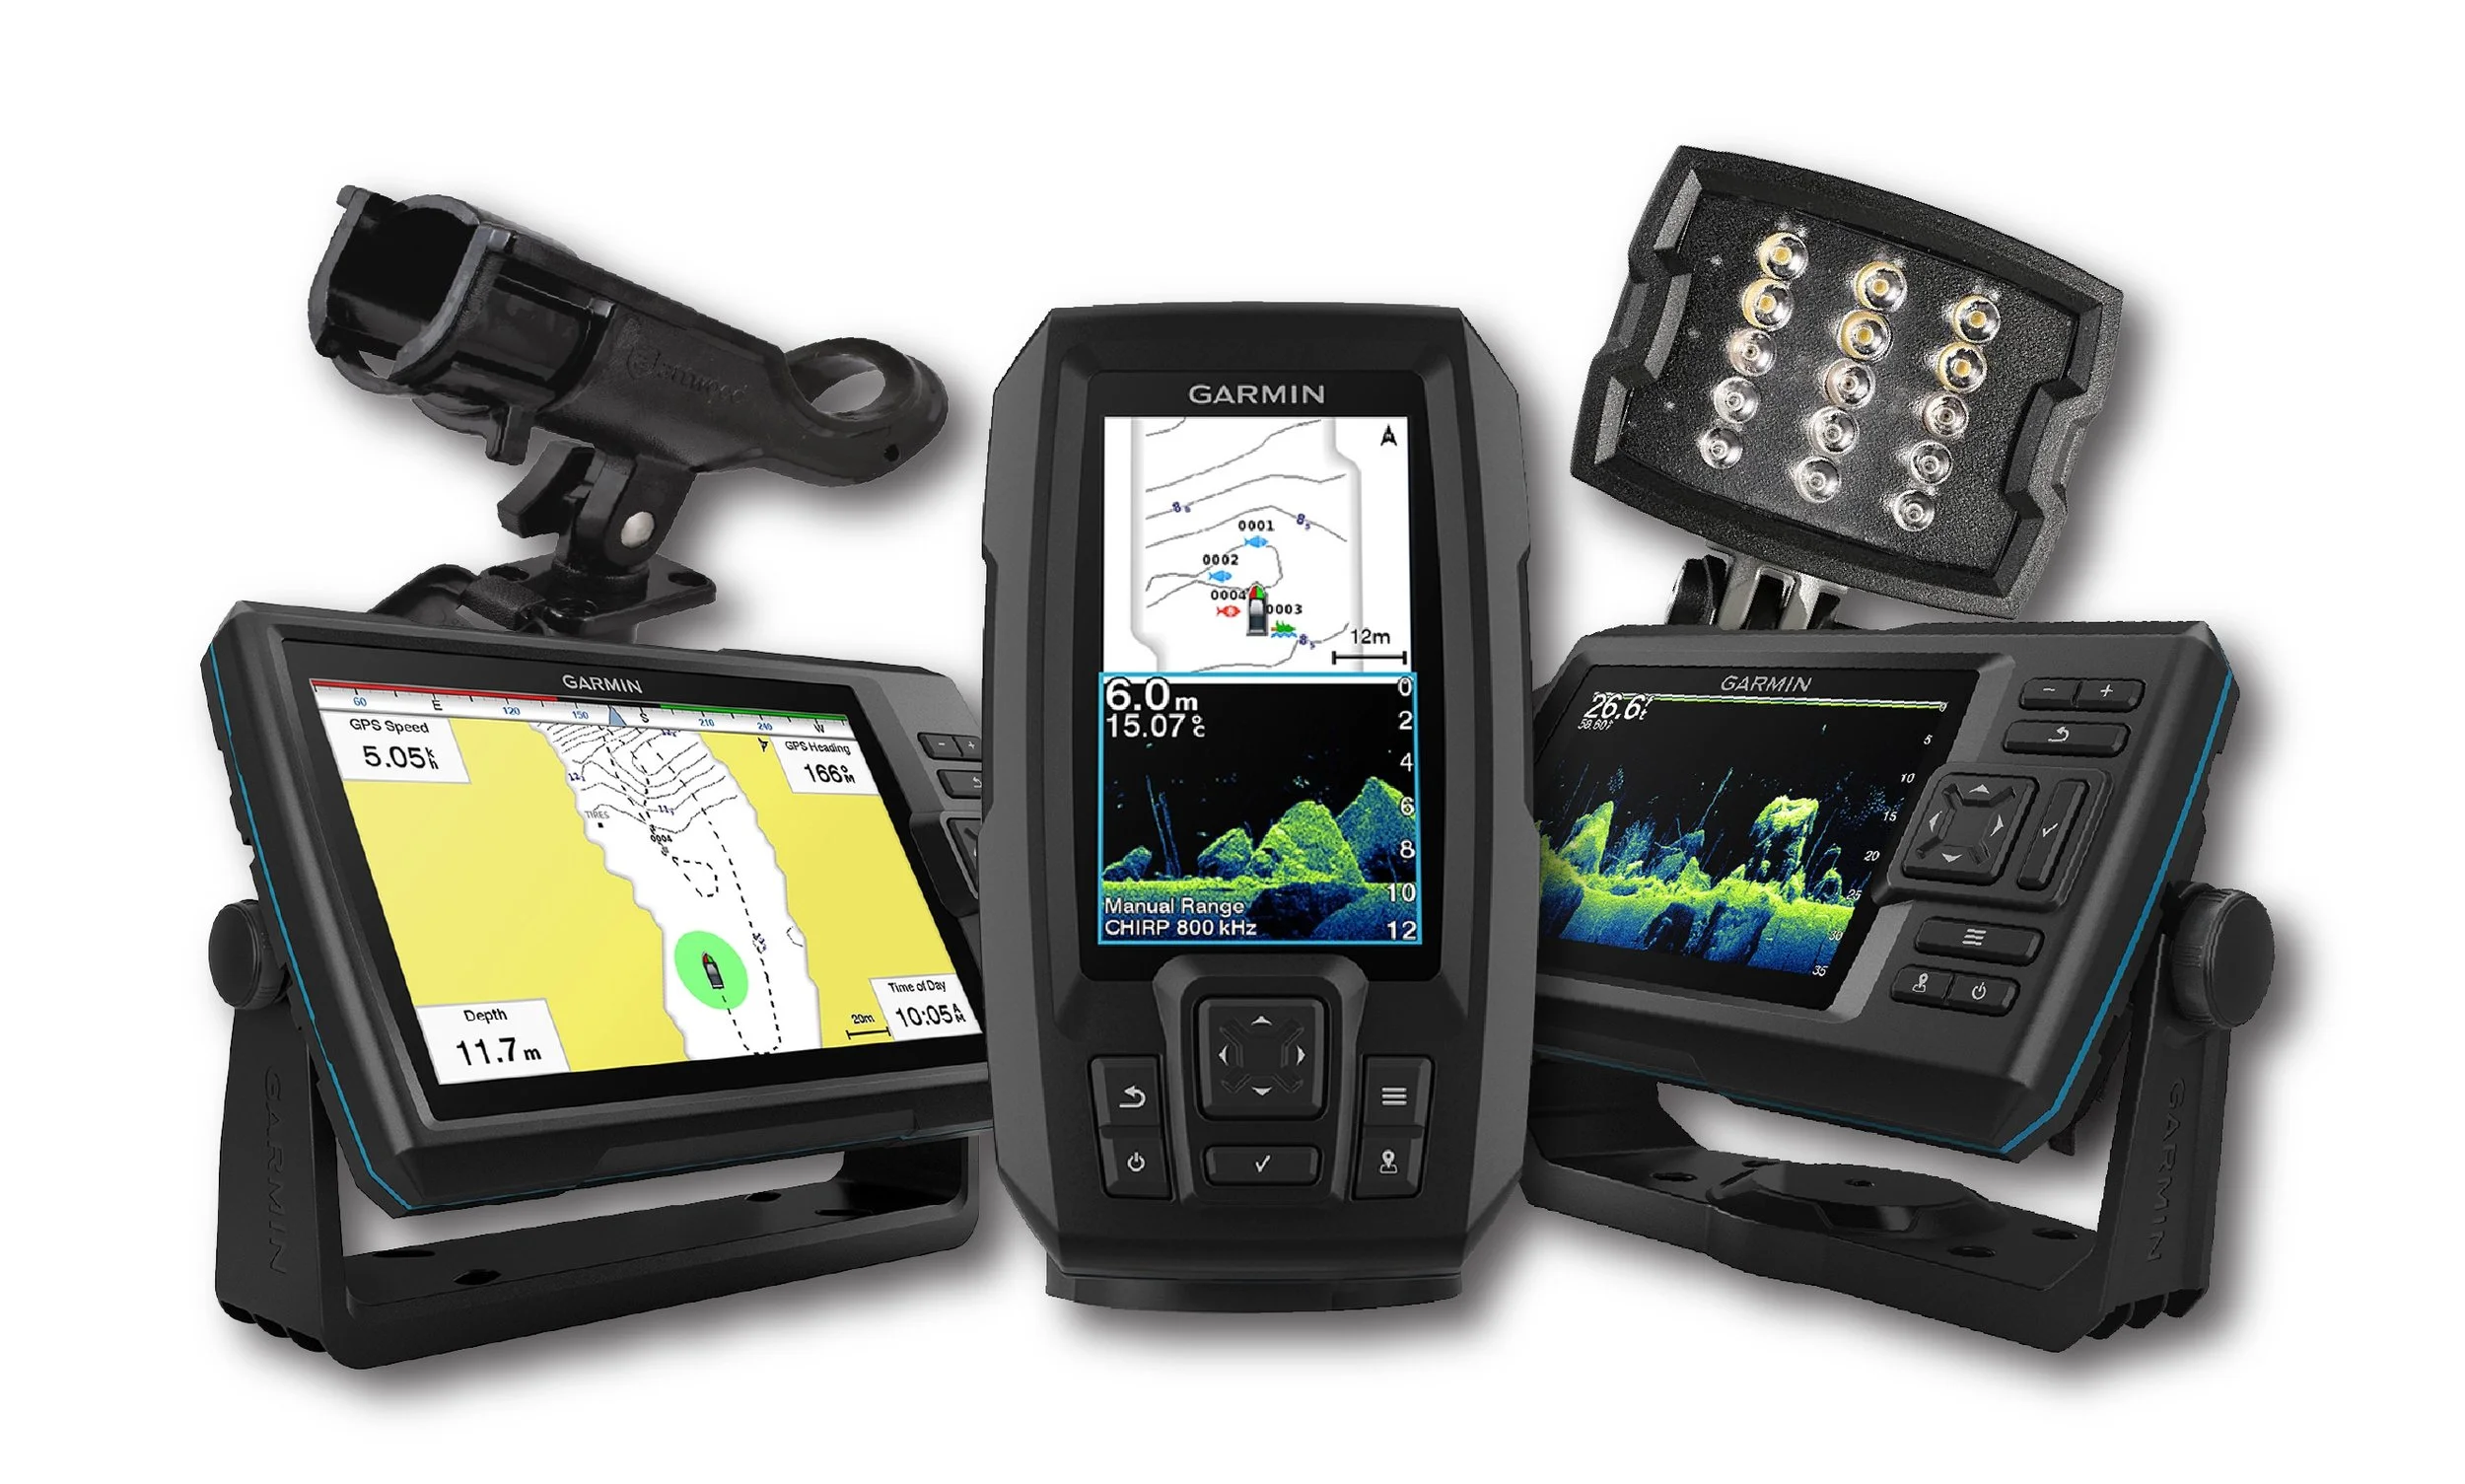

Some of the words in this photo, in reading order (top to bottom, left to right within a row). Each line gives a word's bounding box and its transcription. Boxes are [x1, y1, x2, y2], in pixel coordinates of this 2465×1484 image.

[1189, 385, 1325, 404] GARMIN
[1238, 520, 1275, 531] 0001
[1203, 554, 1239, 565] 0002
[1211, 590, 1246, 601] 0004
[1266, 603, 1303, 614] 0003
[1351, 629, 1390, 645] 12m
[562, 674, 643, 694] GARMIN
[1398, 677, 1414, 696] 0
[1721, 674, 1813, 693] GARMIN
[1105, 677, 1170, 712] 6.0
[1175, 694, 1198, 712] m
[353, 696, 368, 707] 60
[431, 699, 444, 711] E
[502, 706, 521, 717] 120
[572, 710, 590, 720] 150
[639, 712, 650, 724] S
[699, 718, 715, 728] 210
[757, 722, 773, 731] 240
[813, 723, 825, 734] W
[1584, 693, 1646, 720] 26.6
[349, 718, 382, 732] GPS
[385, 720, 430, 735] Speed
[1105, 713, 1186, 738] 15.07
[1398, 711, 1413, 731] 2
[785, 741, 808, 751] GPS
[809, 742, 851, 755] Heading
[1923, 734, 1933, 744] 5
[363, 745, 426, 769] 5.05
[1400, 752, 1414, 772] 4
[1900, 772, 1916, 784] 10
[584, 811, 610, 819] TIRES
[1400, 797, 1414, 816] 6
[1883, 811, 1898, 822] 15
[1400, 840, 1415, 859] 8
[1864, 850, 1880, 862] 20
[1387, 883, 1416, 902] 10
[1846, 888, 1863, 901] 25
[1105, 897, 1174, 914] Manual
[1181, 897, 1244, 918] Range
[1105, 920, 1170, 936] CHIRP
[1177, 920, 1214, 936] 800
[1219, 920, 1257, 936] kHz
[1387, 921, 1416, 941] 12
[1829, 930, 1844, 942] 30
[1812, 965, 1829, 976] 35
[887, 982, 915, 993] Time
[916, 980, 928, 992] of
[926, 979, 946, 993] Day
[463, 1008, 508, 1025] Depth
[851, 1014, 876, 1025] 20m
[895, 1005, 953, 1027] 10:05
[457, 1037, 516, 1066] 11.7
[524, 1048, 541, 1061] m
[264, 1065, 287, 1275] GARMIN
[2147, 1078, 2186, 1263] GARMIN
